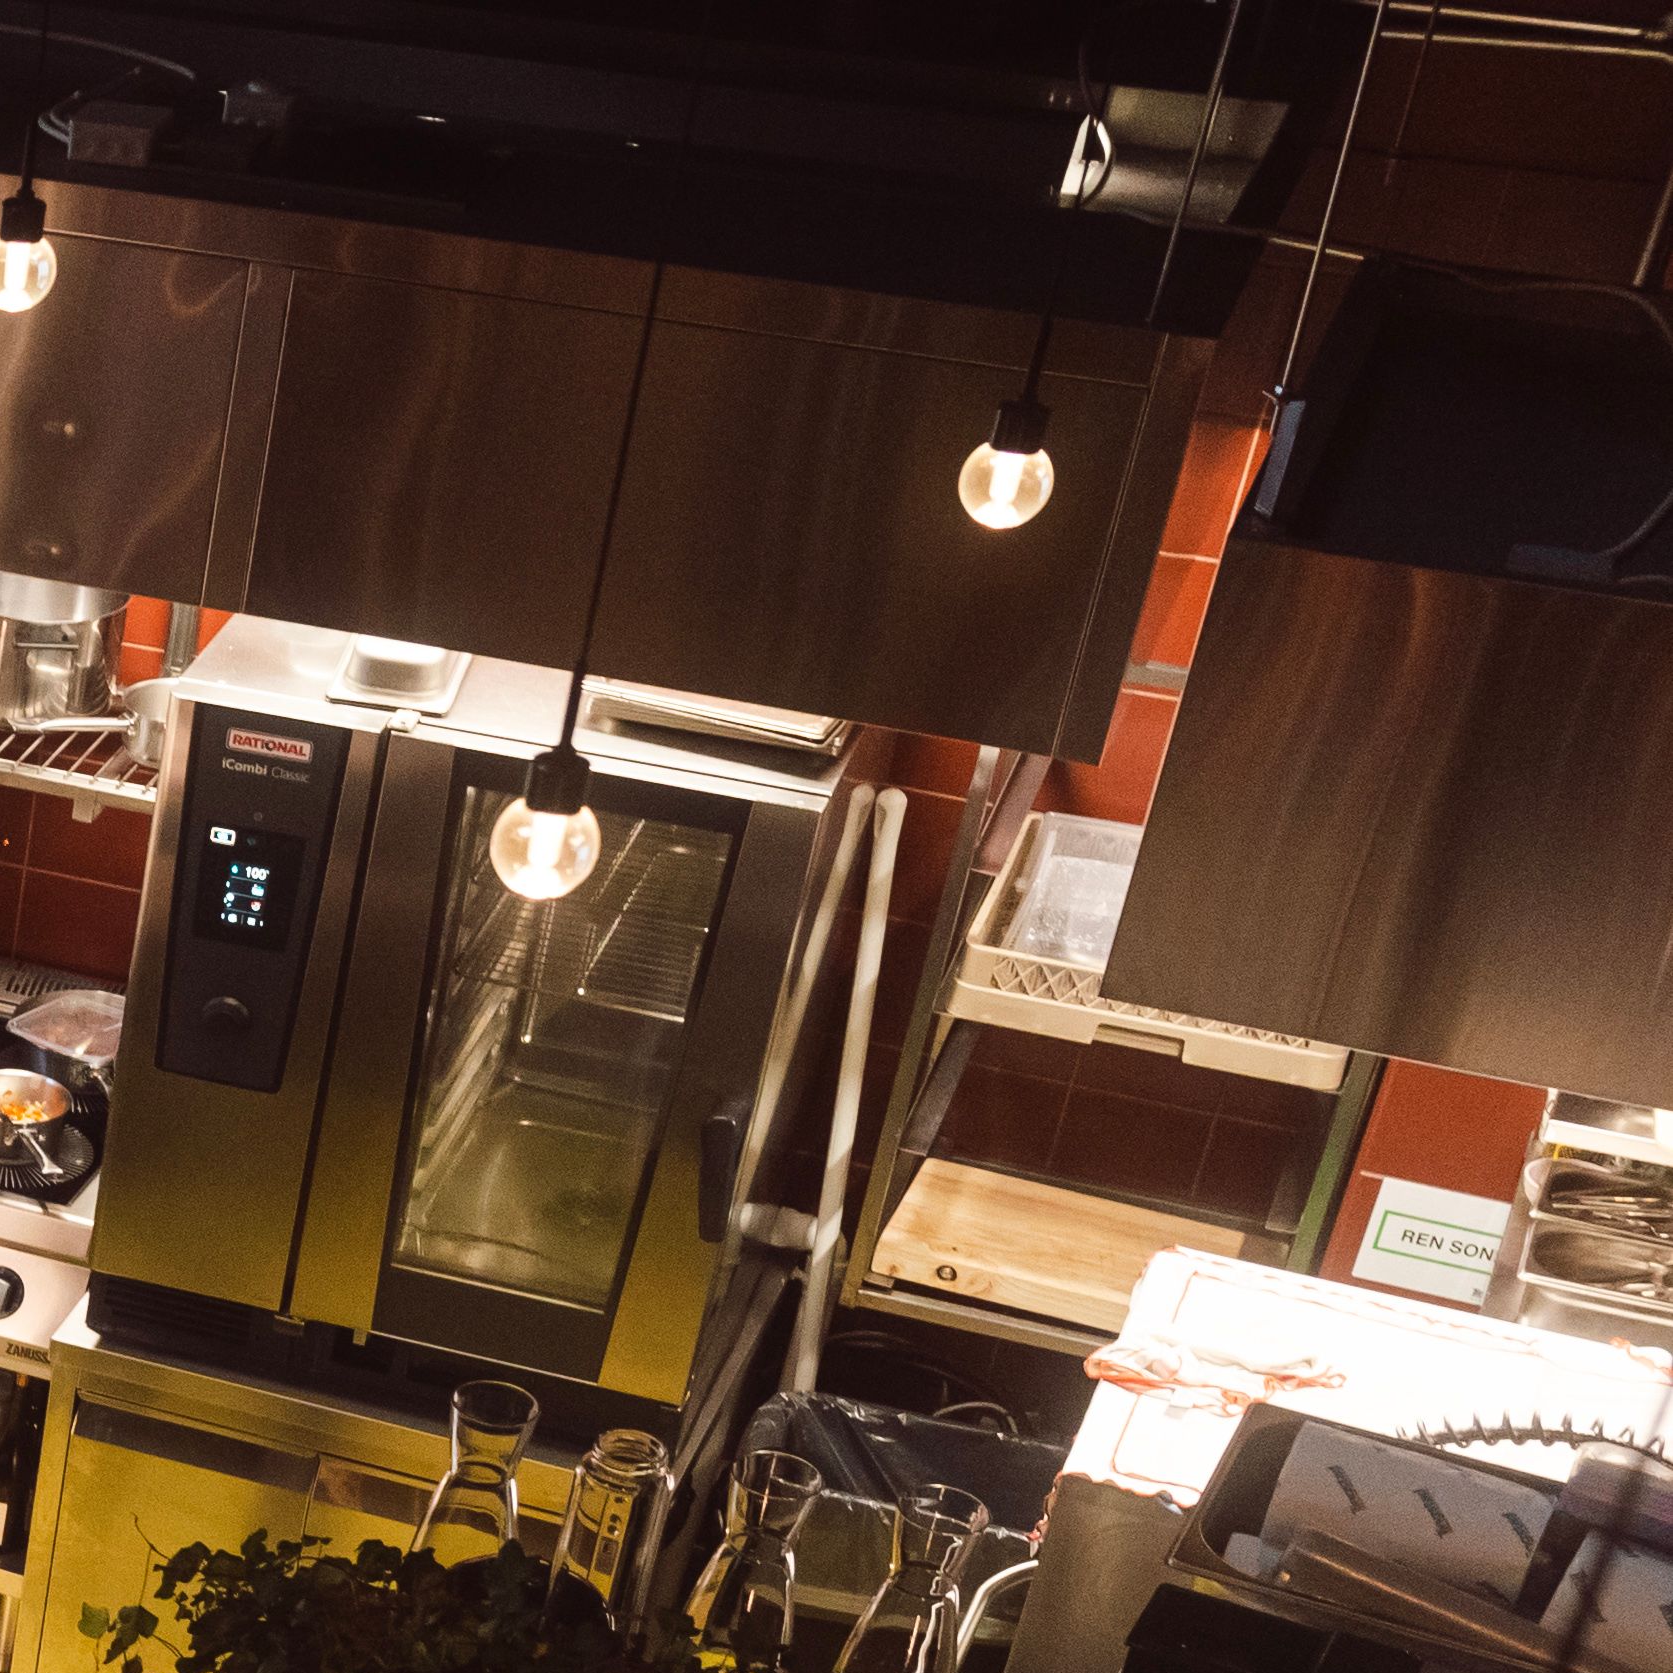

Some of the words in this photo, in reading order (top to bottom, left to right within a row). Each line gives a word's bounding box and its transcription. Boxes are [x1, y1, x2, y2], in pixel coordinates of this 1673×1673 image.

[232, 733, 307, 757] RATIONAL
[221, 756, 268, 776] iCombi
[271, 765, 311, 783] Classic
[1400, 1229, 1445, 1250] REN
[1449, 1240, 1495, 1261] SON
[5, 1341, 51, 1365] ZANUSS
